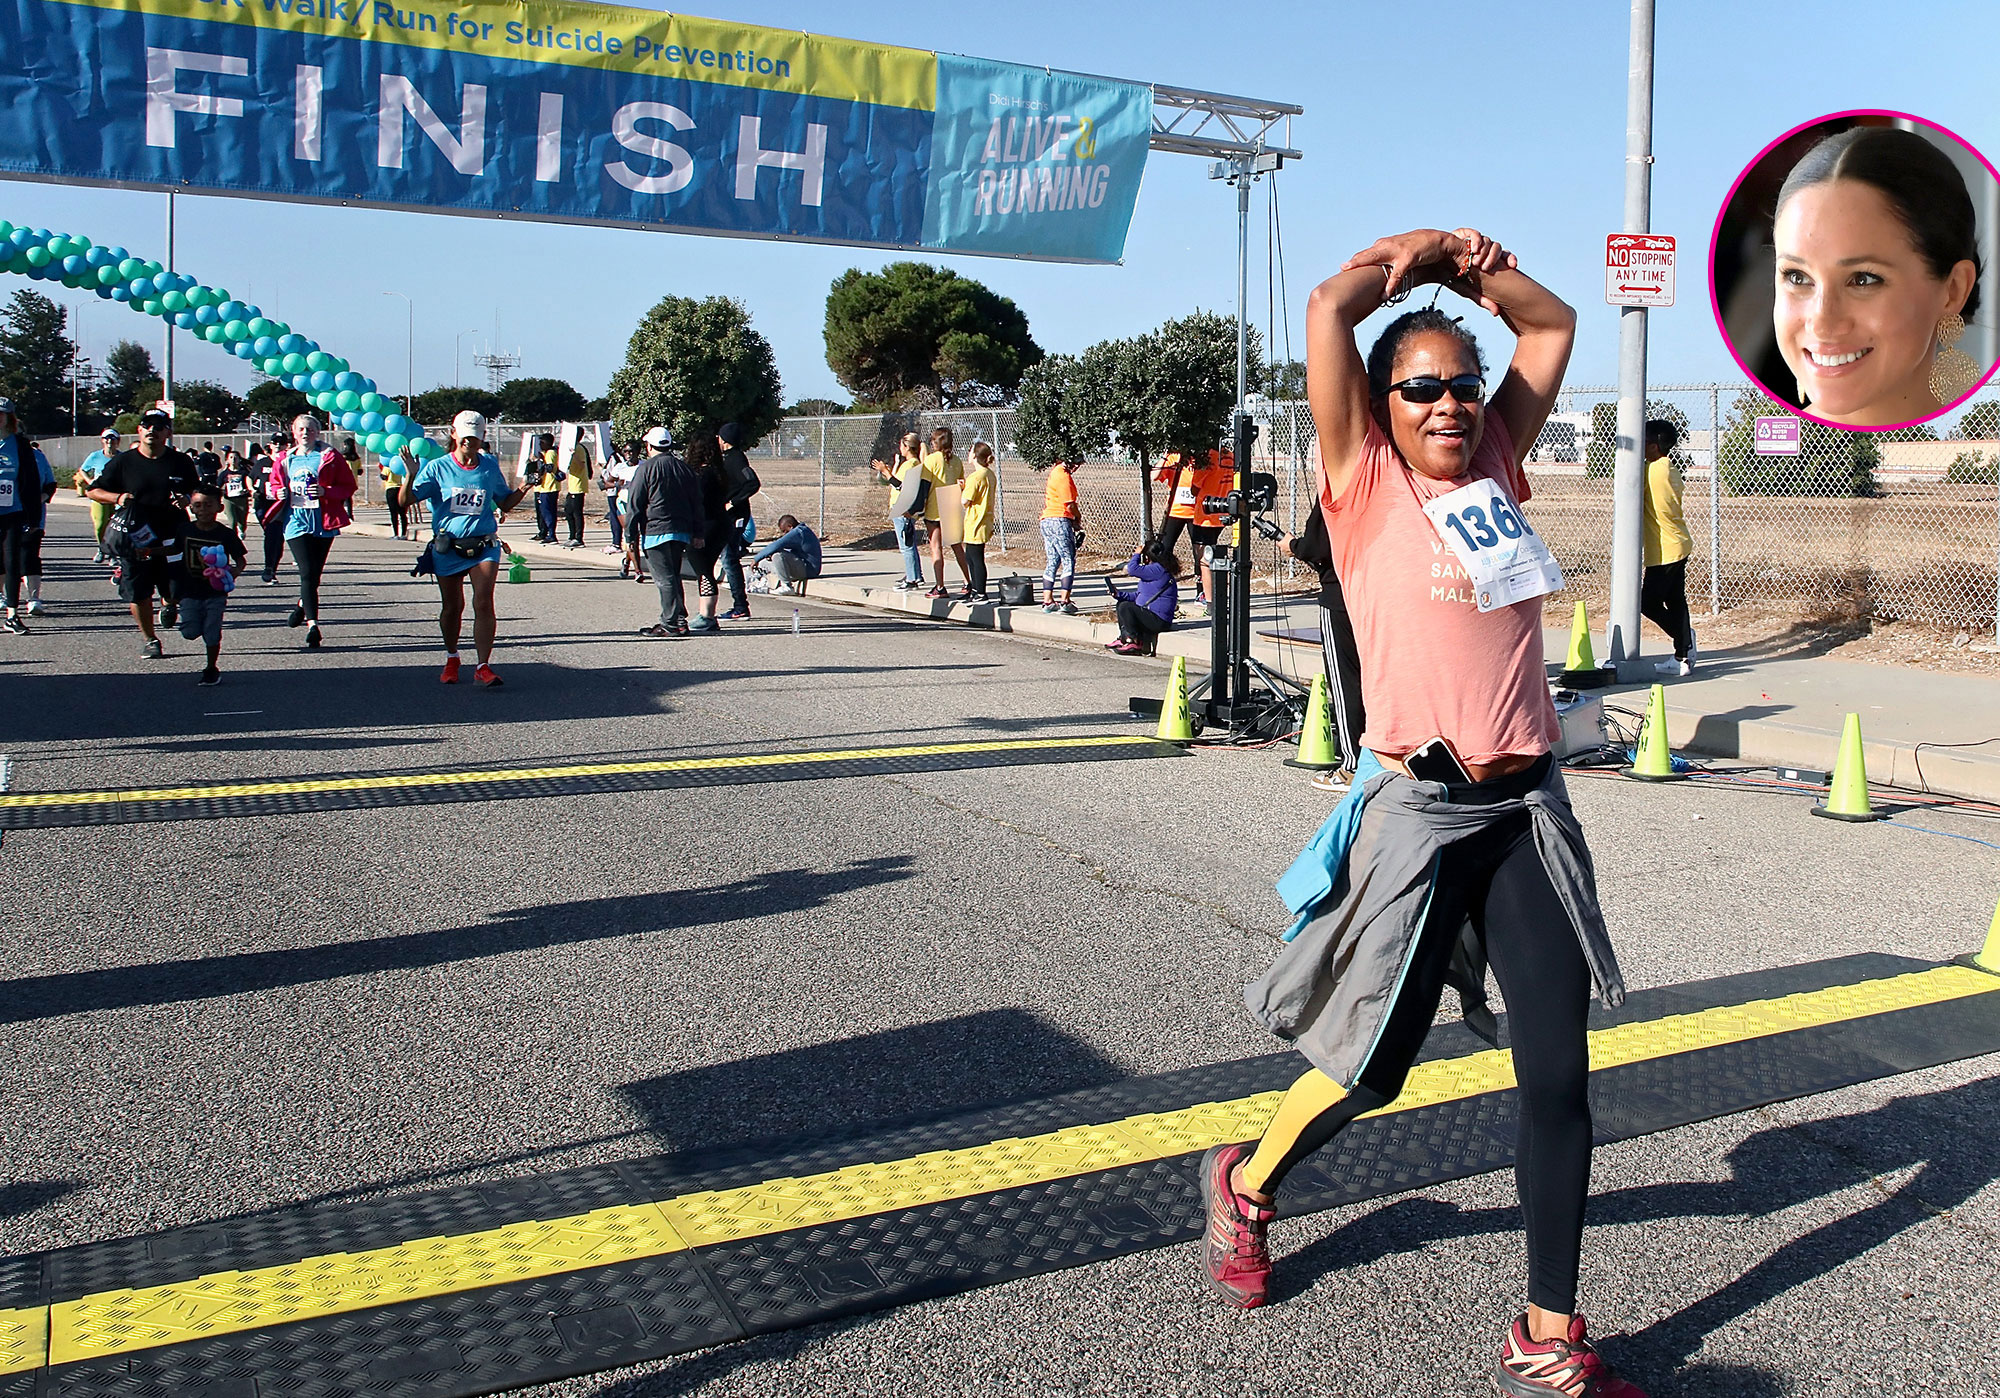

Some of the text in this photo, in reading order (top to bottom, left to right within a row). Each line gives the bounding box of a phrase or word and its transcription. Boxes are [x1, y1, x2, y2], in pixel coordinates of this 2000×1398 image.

[264, 0, 791, 78] Walk/Run for Suicide Prevention
[989, 93, 1049, 112] Didi Hirsch's
[146, 46, 828, 208] FINISH
[980, 115, 1097, 164] ALIVE &
[974, 164, 1111, 216] RUNNING
[1608, 248, 1673, 266] NO STOPPING
[1615, 269, 1666, 282] ANY TIME
[455, 493, 483, 508] 1245
[1430, 562, 1468, 581] SAN
